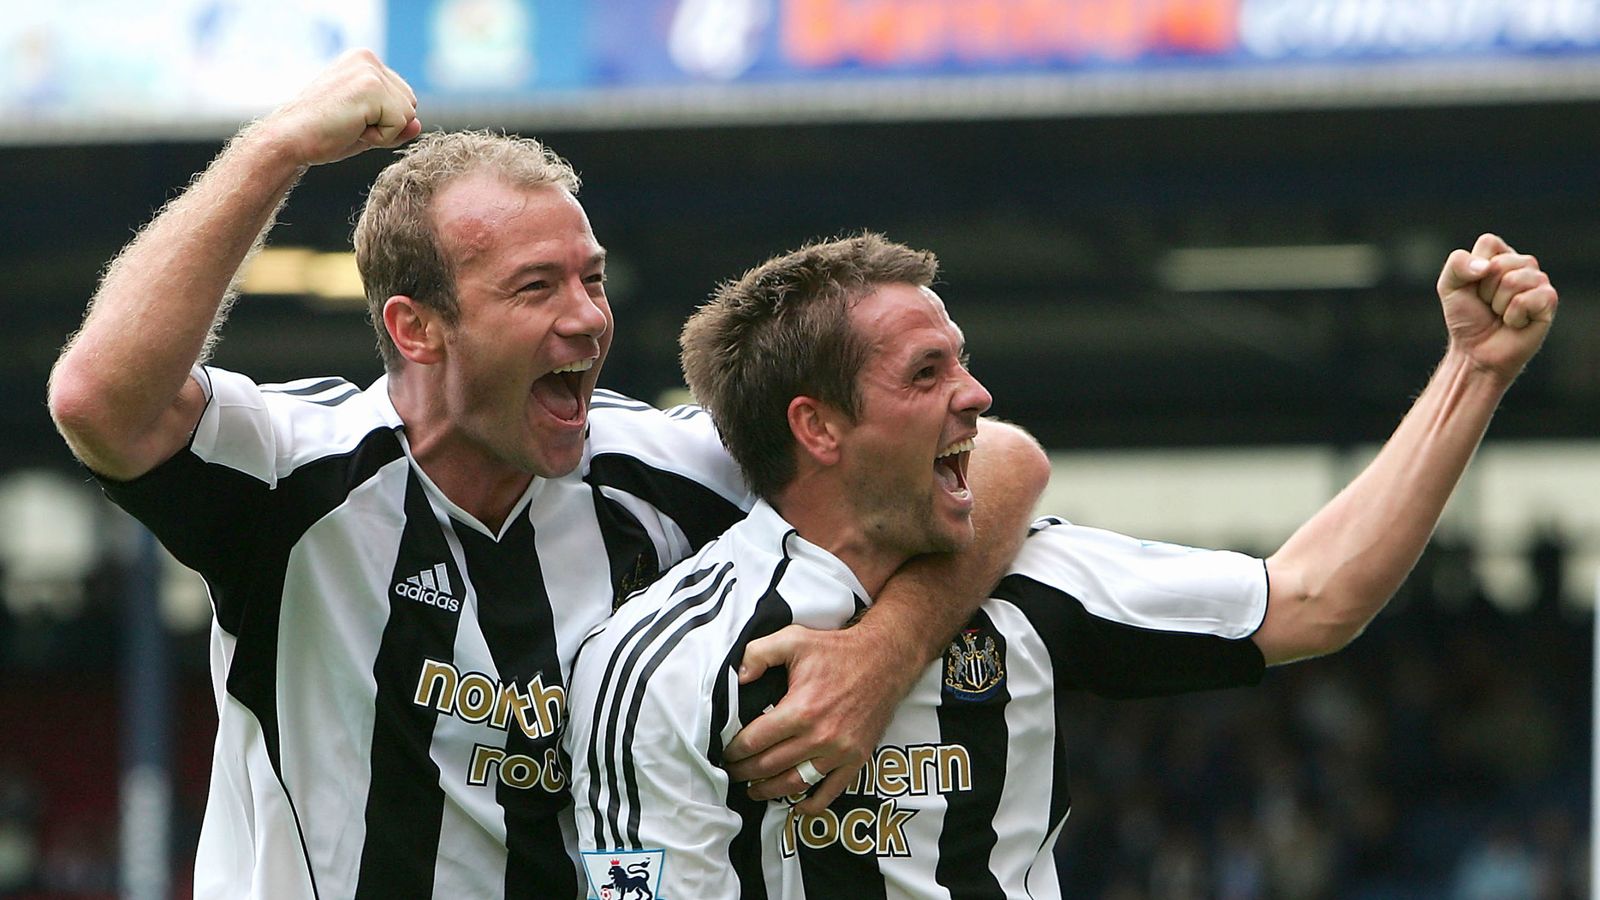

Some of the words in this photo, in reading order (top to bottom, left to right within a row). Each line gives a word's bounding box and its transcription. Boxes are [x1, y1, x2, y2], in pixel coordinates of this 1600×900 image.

[395, 581, 461, 613] adidas
[466, 743, 566, 793] roc
[780, 798, 916, 858] rock
